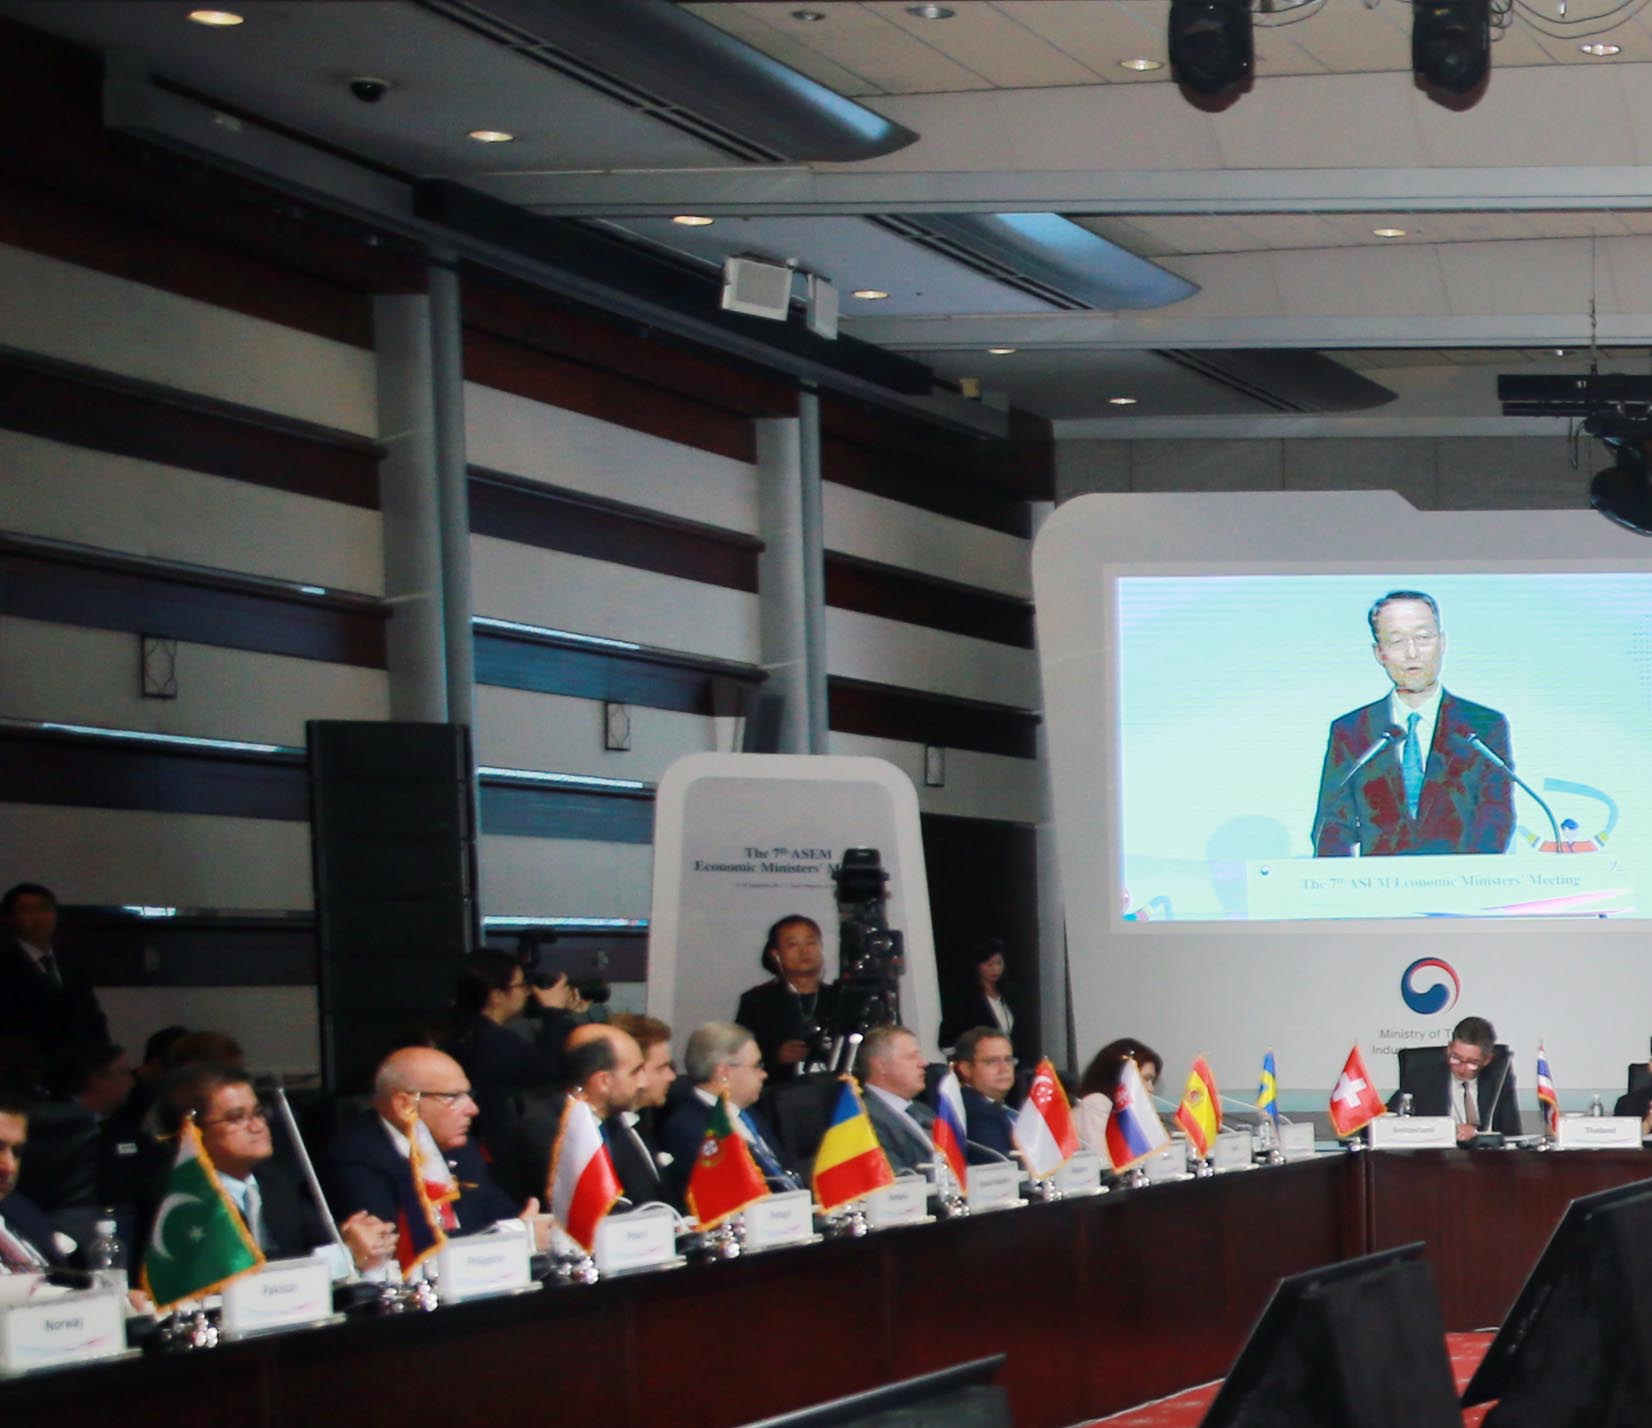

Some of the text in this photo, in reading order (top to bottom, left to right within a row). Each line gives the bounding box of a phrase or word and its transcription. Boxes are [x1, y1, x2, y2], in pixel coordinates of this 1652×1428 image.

[744, 847, 769, 859] The
[791, 848, 832, 860] ASEM
[694, 860, 755, 873] Economic
[1528, 873, 1581, 888] Meeting
[1379, 1029, 1425, 1041] Ministry
[1428, 1029, 1441, 1040] of
[44, 1318, 85, 1334] Norway
